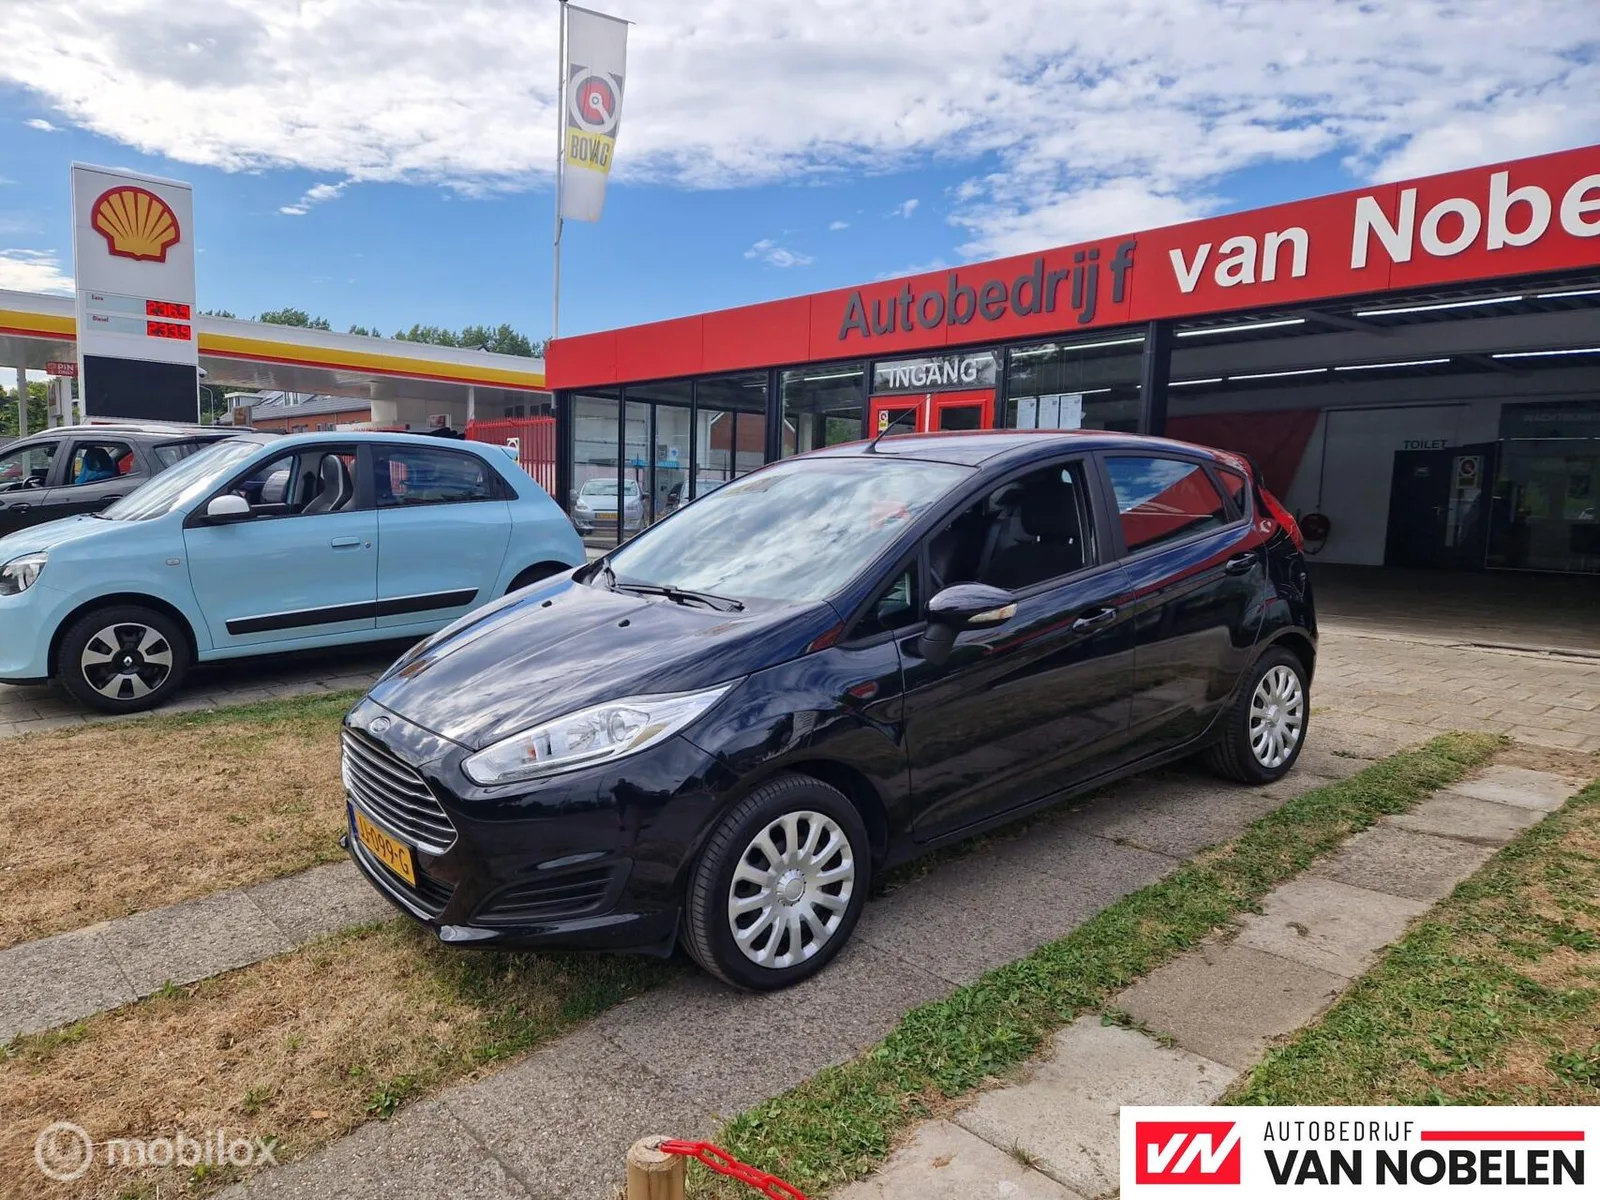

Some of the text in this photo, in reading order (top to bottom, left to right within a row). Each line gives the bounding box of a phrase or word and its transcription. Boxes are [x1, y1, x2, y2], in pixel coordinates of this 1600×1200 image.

[571, 135, 609, 167] BOVAG
[839, 171, 1600, 341] Autobedrijf van Nobe
[92, 315, 109, 323] Diesel
[57, 363, 74, 371] PIN
[888, 358, 978, 389] INGANG
[1403, 439, 1448, 450] TOILET
